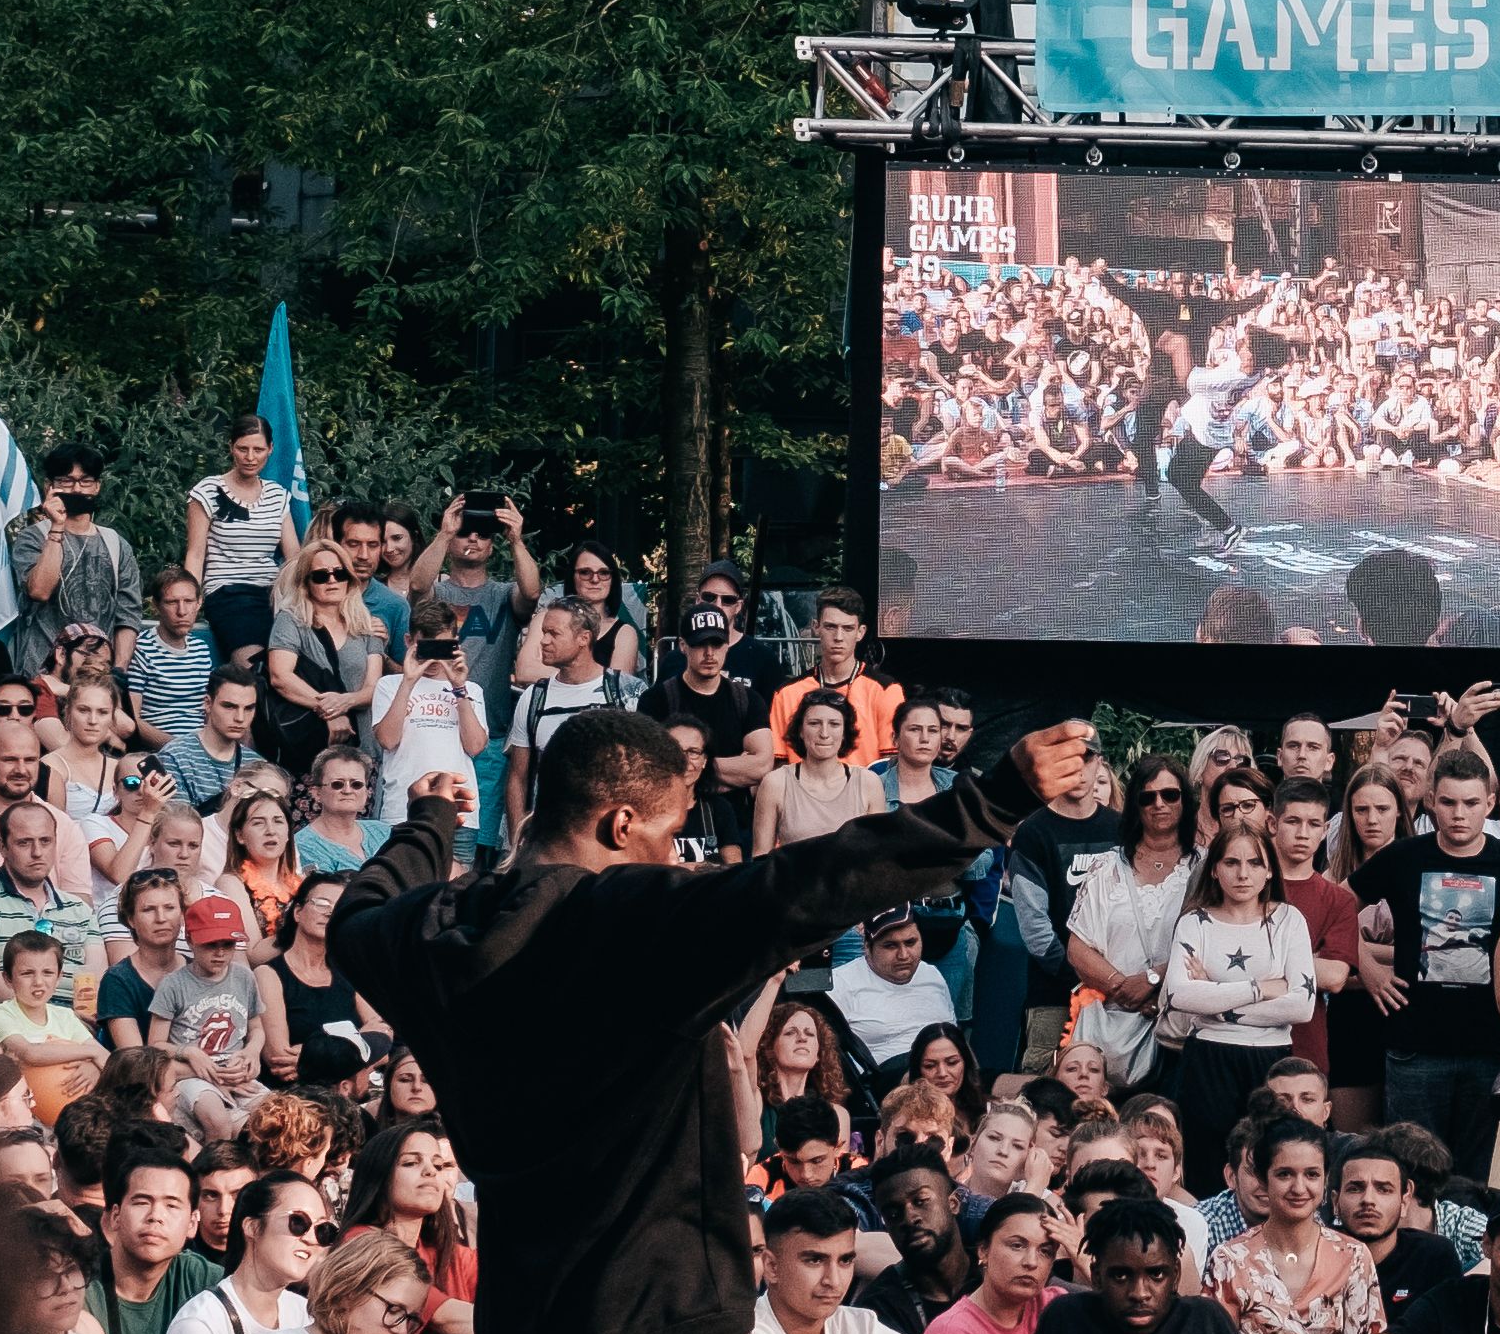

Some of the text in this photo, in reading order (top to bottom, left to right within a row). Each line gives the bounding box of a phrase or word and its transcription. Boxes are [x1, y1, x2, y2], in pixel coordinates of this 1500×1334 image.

[909, 195, 996, 222] RUHR
[909, 224, 1017, 253] GAMES
[908, 255, 941, 283] 19
